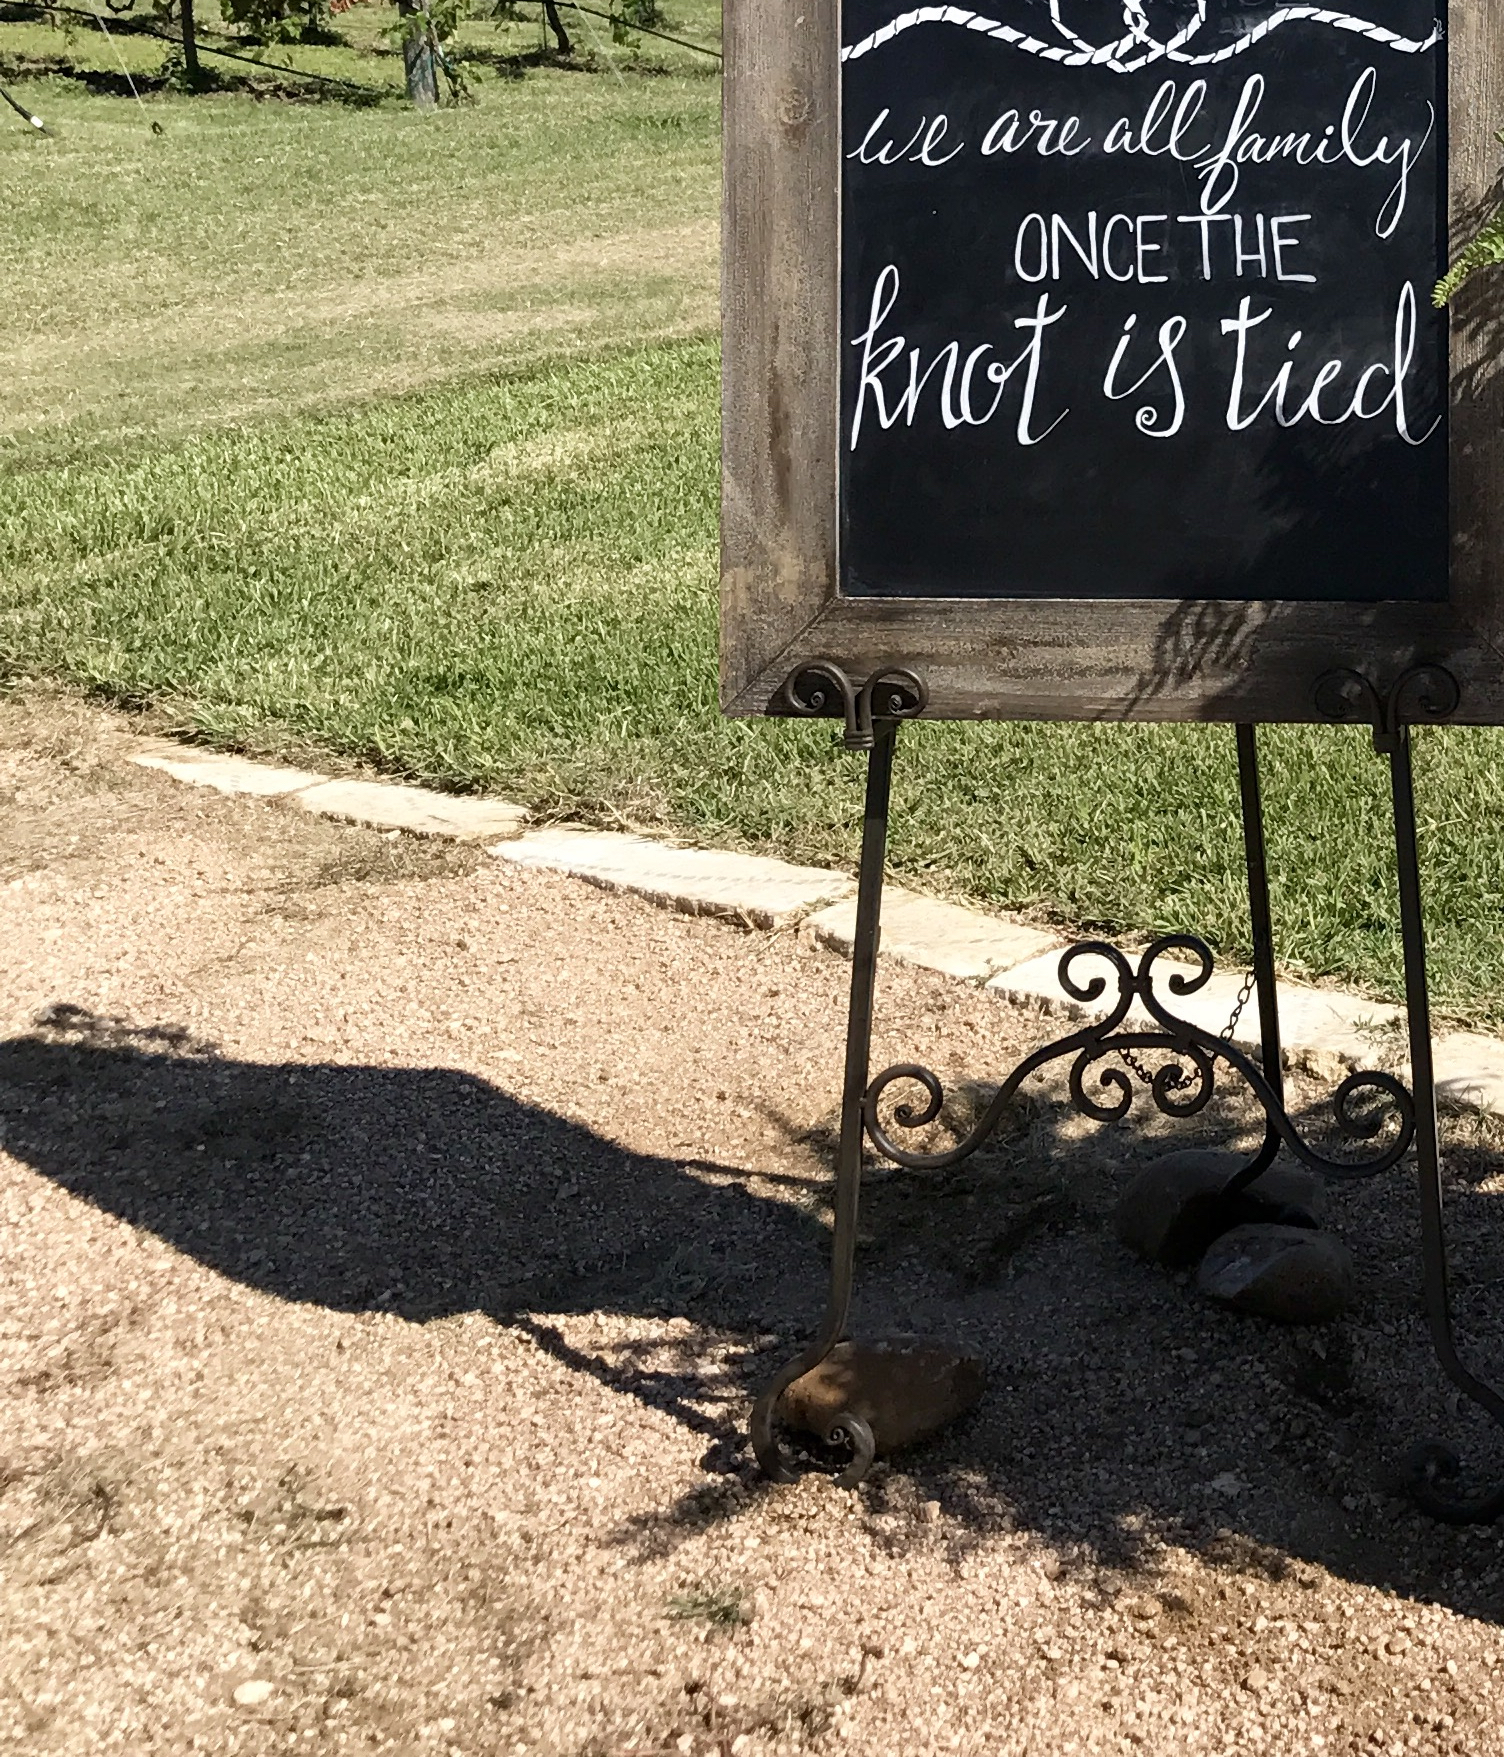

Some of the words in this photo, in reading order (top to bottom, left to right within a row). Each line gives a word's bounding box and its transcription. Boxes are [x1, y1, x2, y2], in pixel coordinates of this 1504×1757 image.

[847, 108, 965, 167] we
[980, 108, 1092, 156] are
[1102, 79, 1213, 161] all
[1200, 66, 1436, 239] family
[1014, 210, 1169, 284] ONCE
[1176, 213, 1317, 283] THE
[850, 264, 1070, 451] knot
[1103, 313, 1187, 438] is
[1220, 281, 1442, 446] tied
